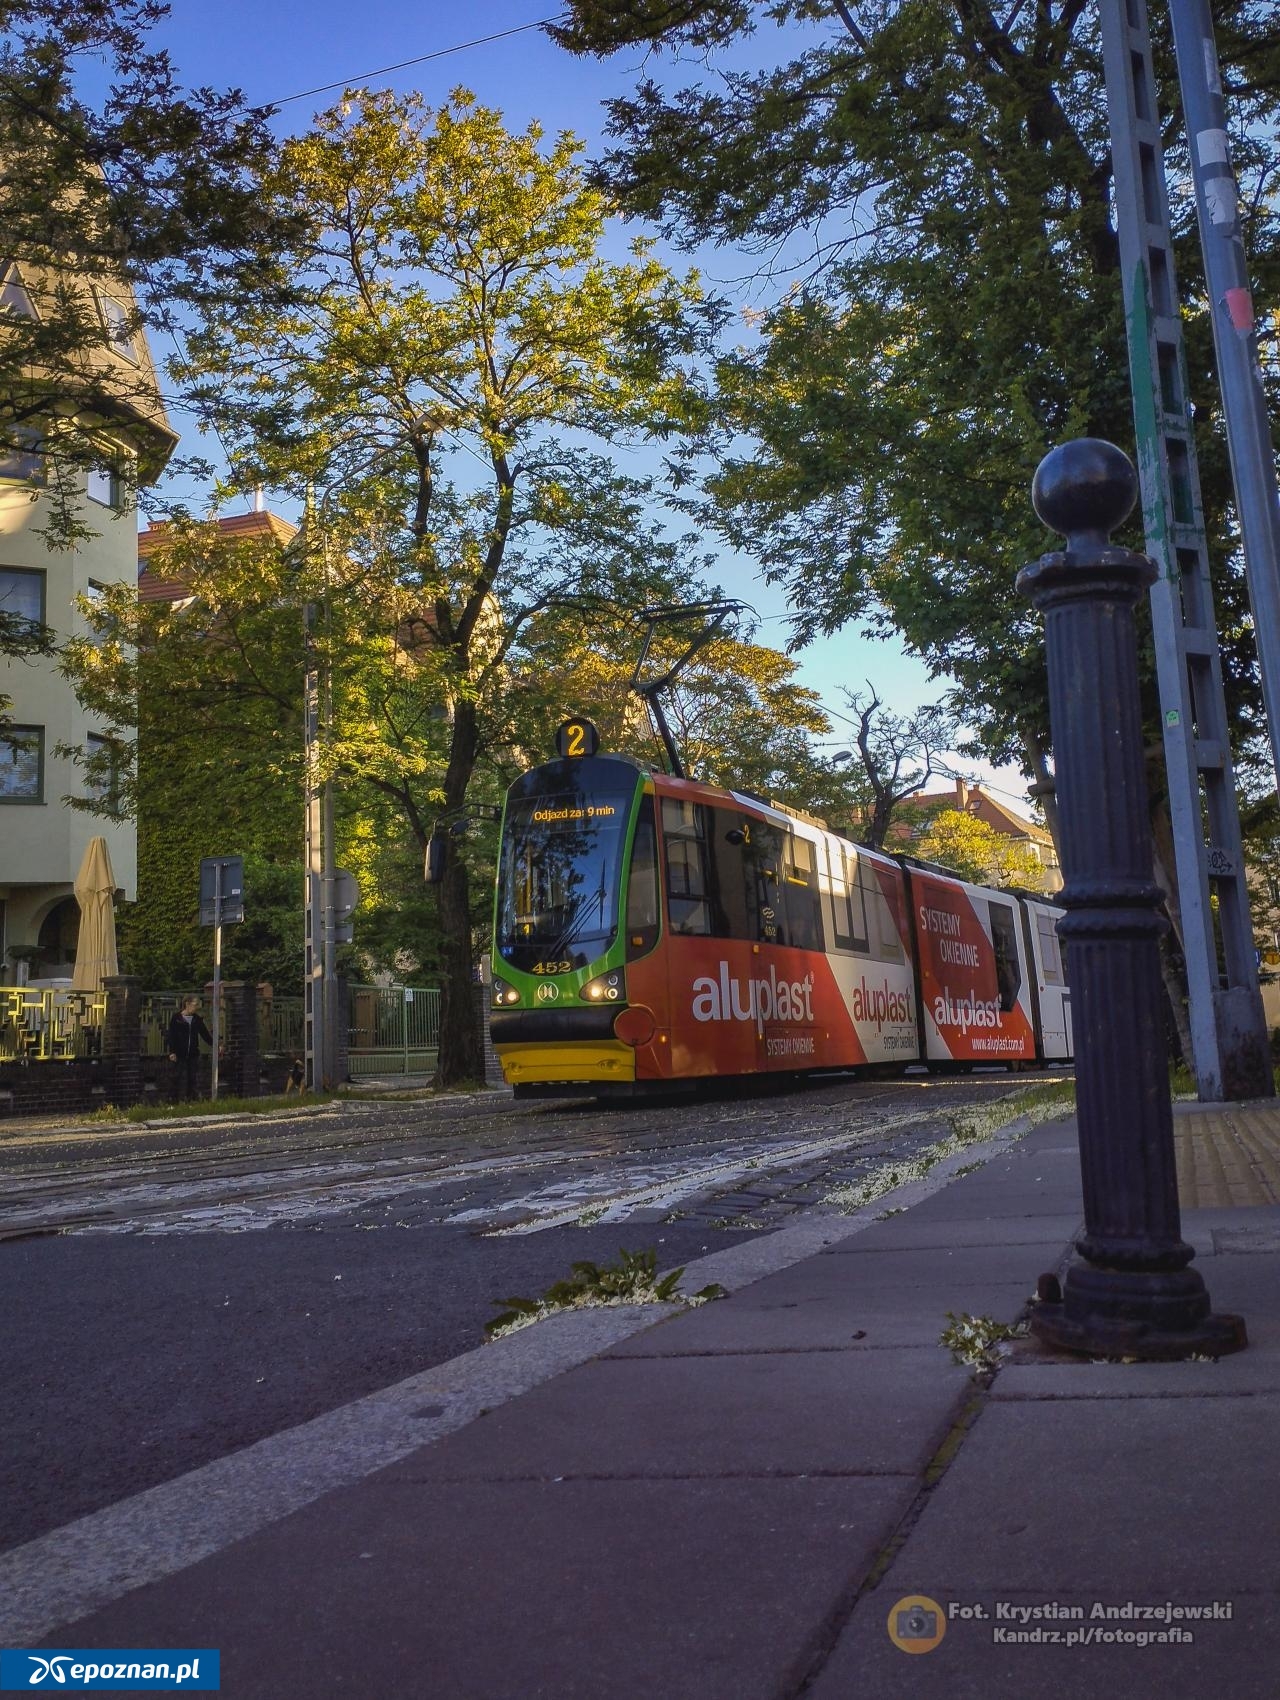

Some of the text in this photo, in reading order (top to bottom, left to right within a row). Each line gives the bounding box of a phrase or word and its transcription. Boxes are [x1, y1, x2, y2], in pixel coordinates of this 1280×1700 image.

[567, 725, 585, 756] 2
[534, 808, 568, 821] Odjazd
[587, 807, 594, 817] 9
[596, 806, 615, 816] min
[744, 824, 751, 844] 2
[920, 906, 961, 937] SYSTEMY
[940, 940, 980, 968] OKIENNE
[532, 961, 571, 974] 452
[766, 1037, 815, 1056] SYSTEMY OKIENNE
[971, 1035, 1025, 1055] www.aluplast.com.pl
